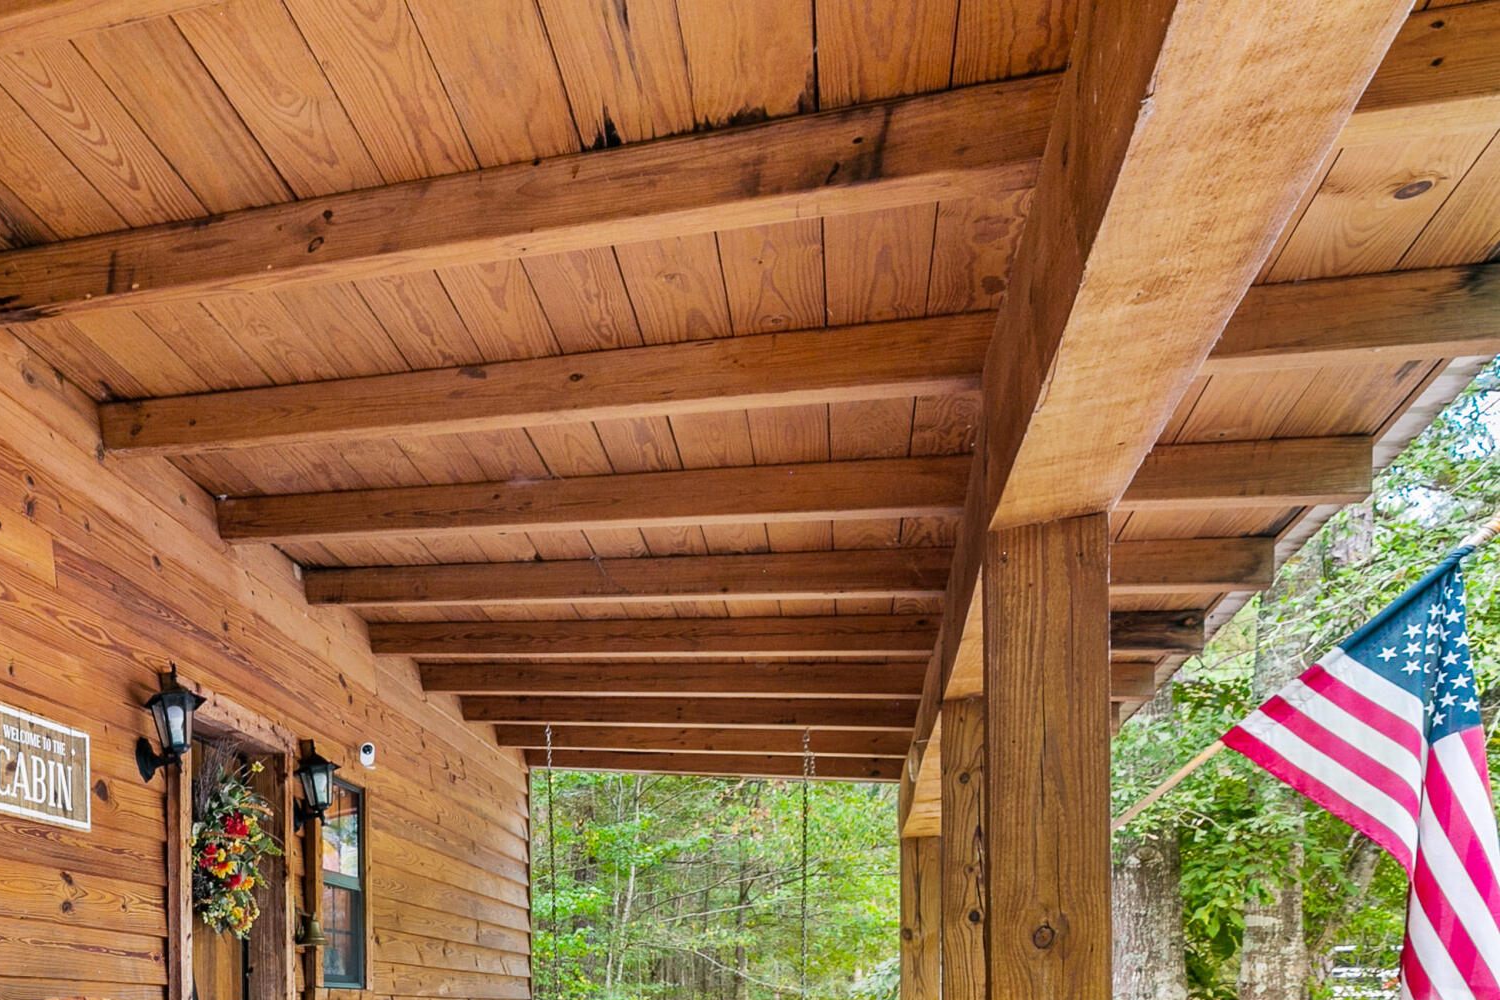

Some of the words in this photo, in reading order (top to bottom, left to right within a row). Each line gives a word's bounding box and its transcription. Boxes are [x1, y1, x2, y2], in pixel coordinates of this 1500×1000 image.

[3, 724, 41, 749] WELCOME
[42, 736, 51, 752] TO
[52, 739, 66, 757] THE
